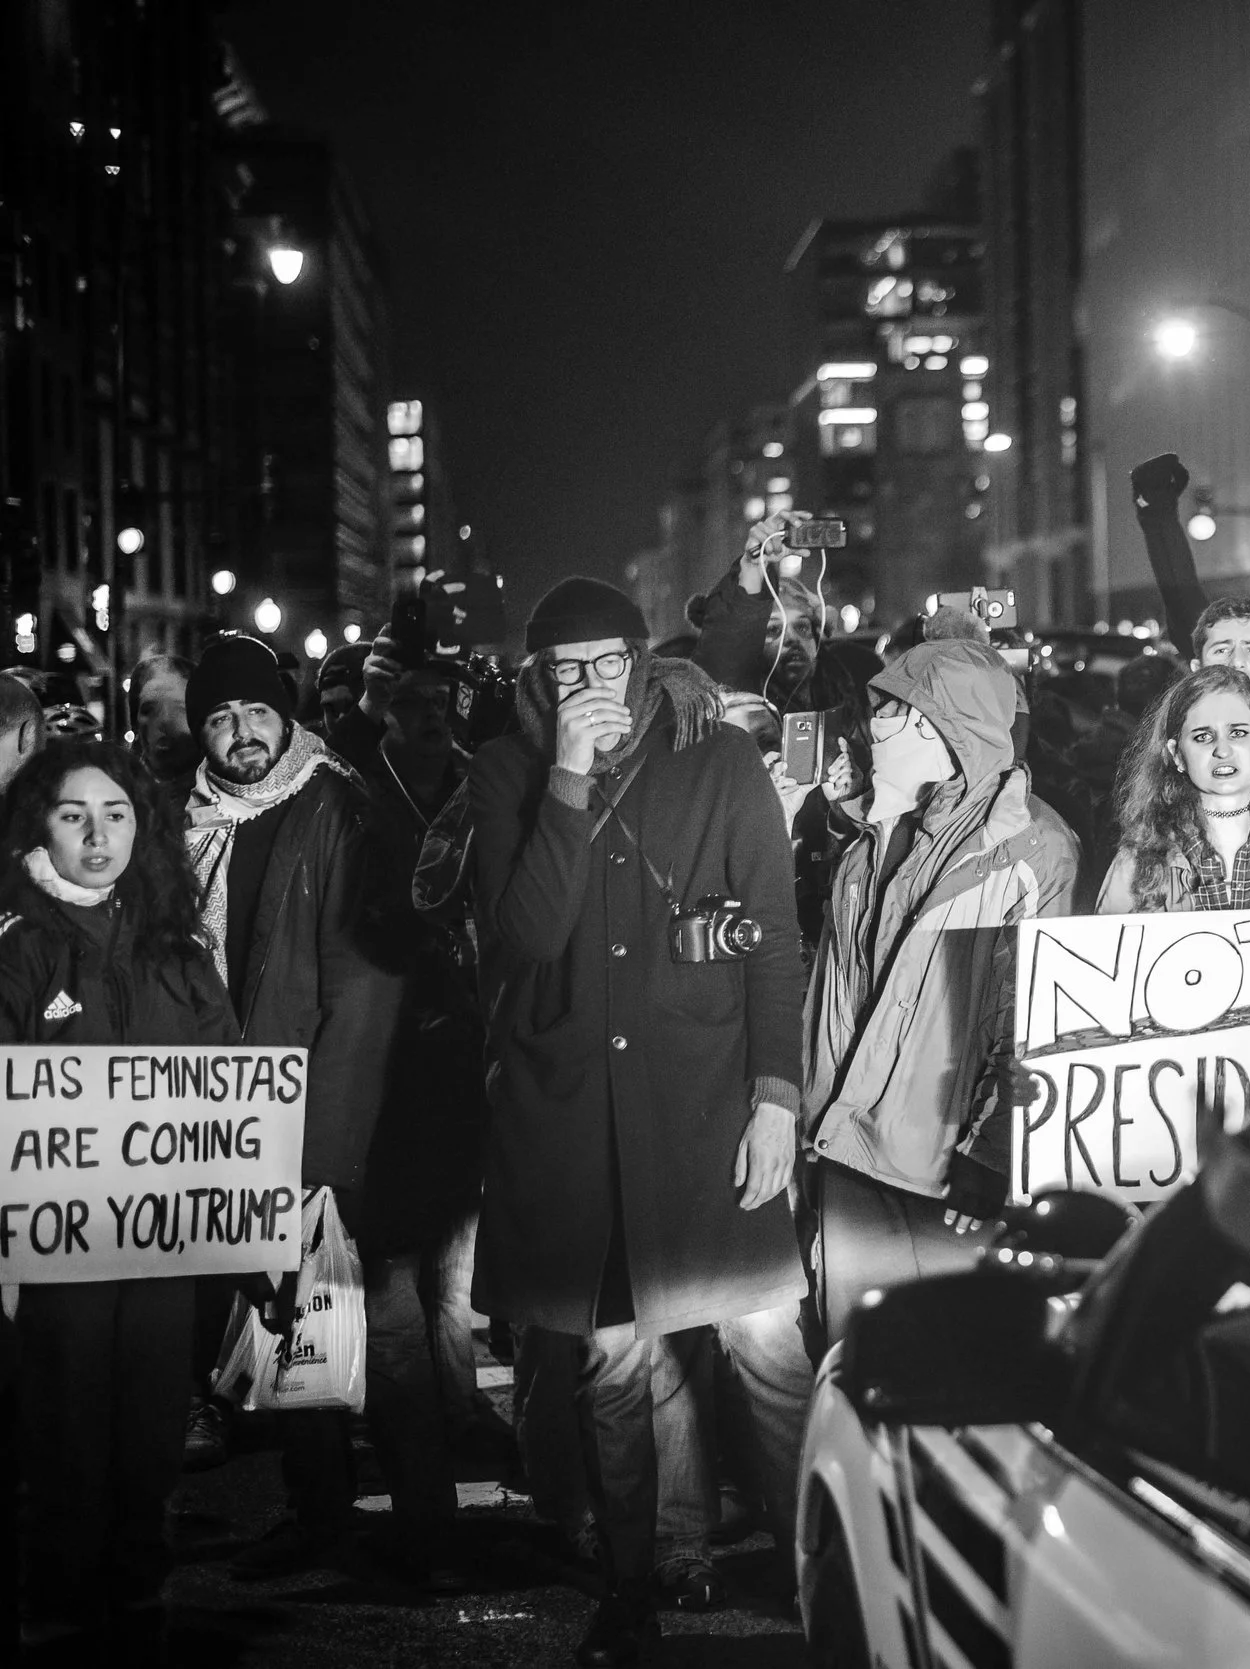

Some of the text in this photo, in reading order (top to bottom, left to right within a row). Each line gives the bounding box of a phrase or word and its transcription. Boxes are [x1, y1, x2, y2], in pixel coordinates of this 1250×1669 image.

[43, 1003, 83, 1020] adidas
[5, 1054, 304, 1104] LAS FEMINISTAS
[10, 1116, 262, 1172] ARE COMING
[0, 1199, 90, 1258] FOR
